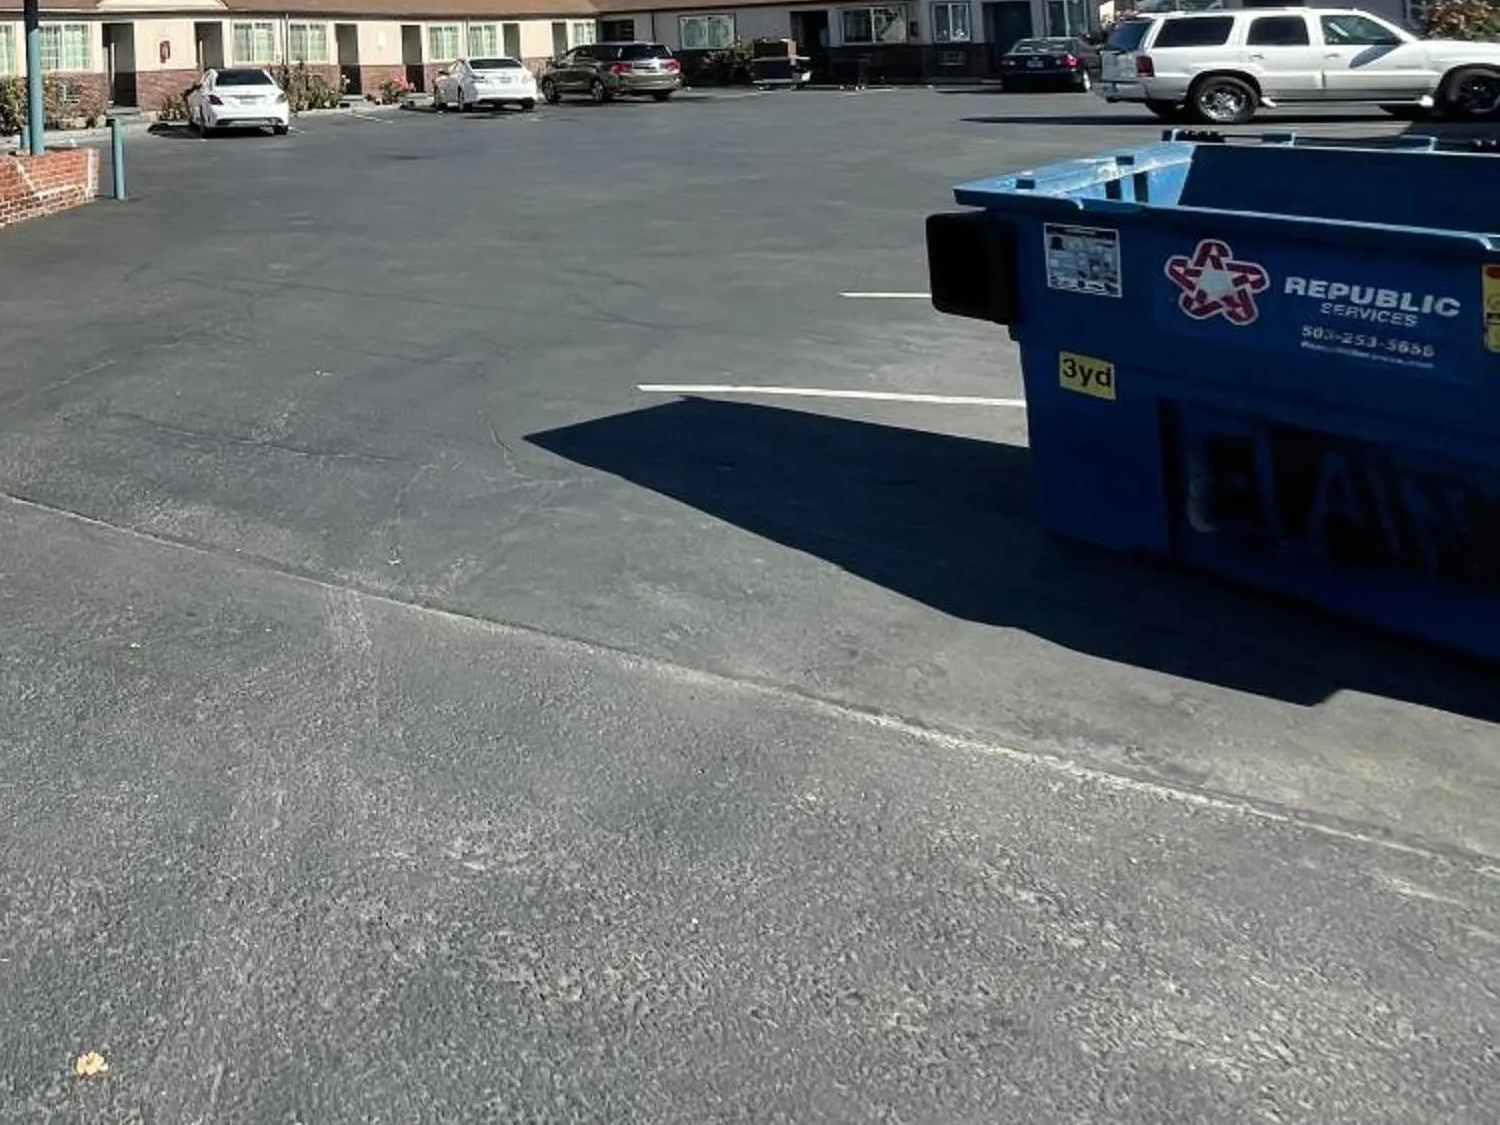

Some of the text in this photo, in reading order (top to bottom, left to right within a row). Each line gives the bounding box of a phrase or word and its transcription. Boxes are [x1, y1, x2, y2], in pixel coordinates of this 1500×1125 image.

[1284, 276, 1461, 317] REPUBLIC
[1320, 302, 1419, 327] SERVICES
[1063, 358, 1111, 388] 3yd
